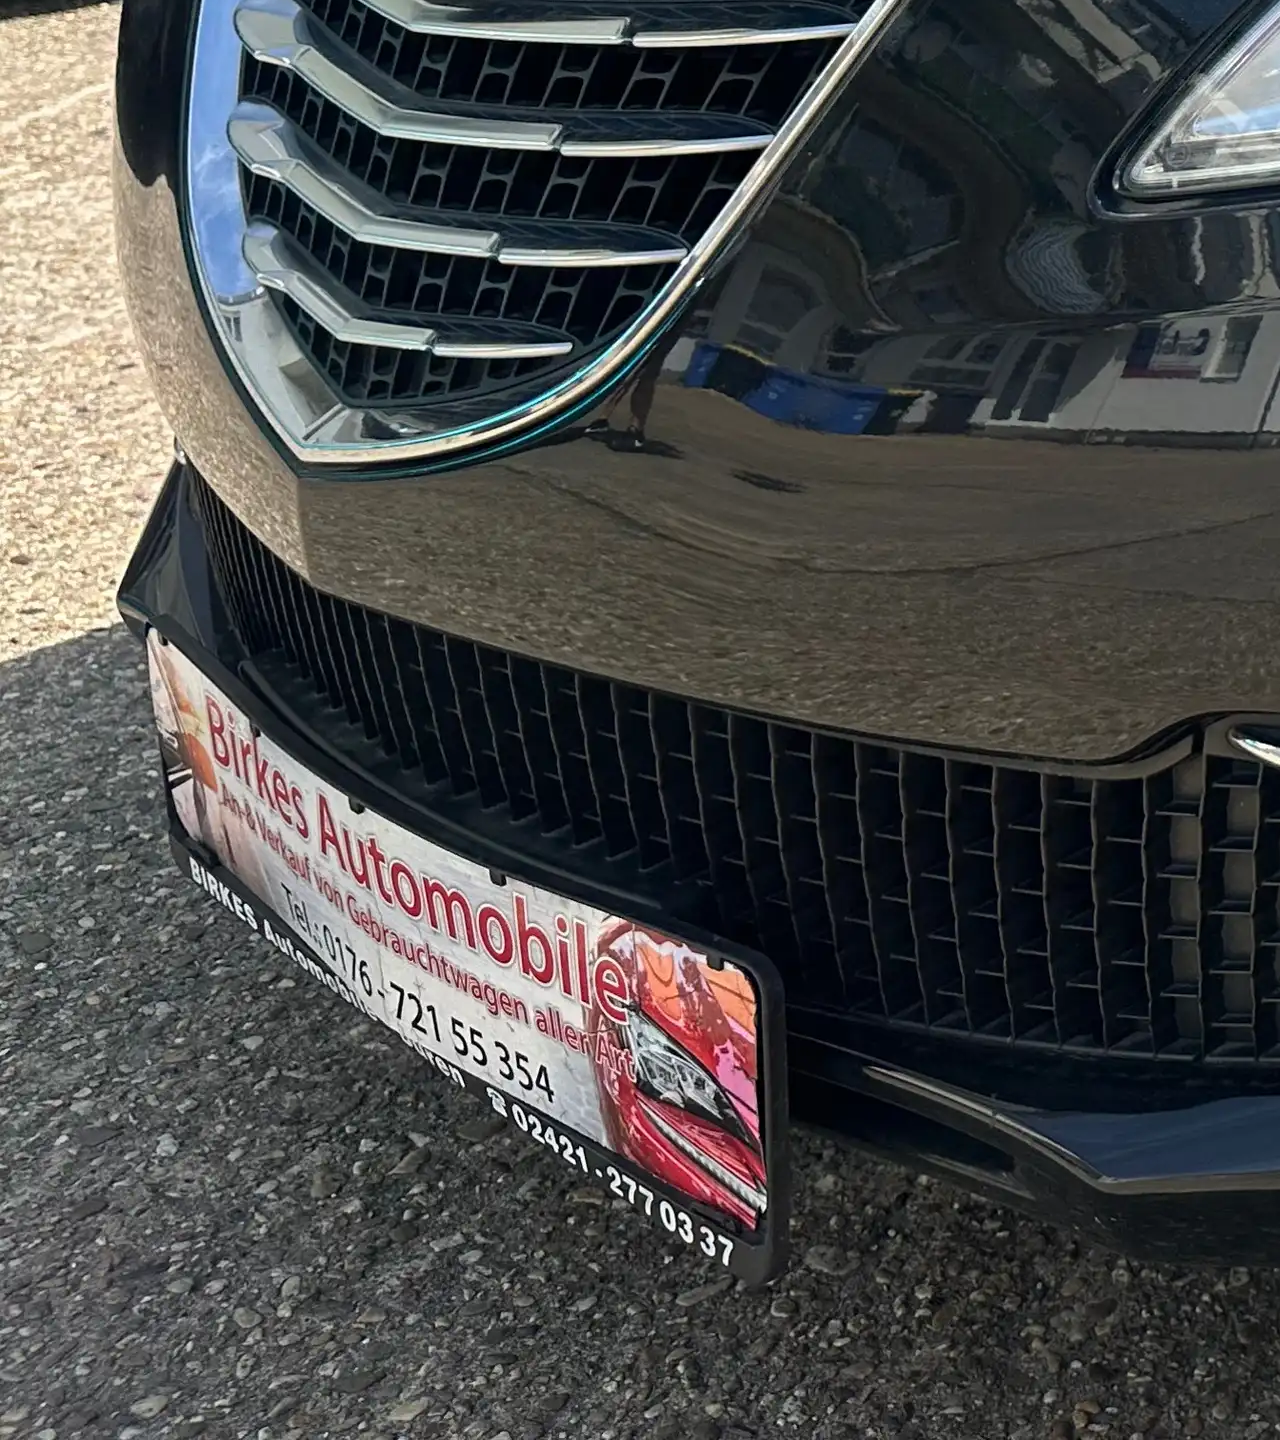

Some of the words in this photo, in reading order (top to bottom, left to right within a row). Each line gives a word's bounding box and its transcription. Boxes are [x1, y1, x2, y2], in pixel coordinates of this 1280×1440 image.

[189, 856, 259, 930] BIRKES
[205, 693, 310, 842] Birkes
[315, 790, 631, 1026] Automobile
[256, 810, 311, 882] Verkauf
[314, 871, 344, 912] von
[347, 894, 529, 1025] Gebrauchtwagen
[535, 1004, 590, 1057] aller
[595, 1020, 638, 1083] Art
[323, 925, 374, 997] 0176
[390, 981, 442, 1043] 721
[451, 1017, 488, 1067] 55
[494, 1041, 554, 1102] 354
[511, 1104, 589, 1173] 02421
[607, 1166, 655, 1216] 277
[660, 1201, 694, 1243] 03
[700, 1226, 734, 1267] 37
